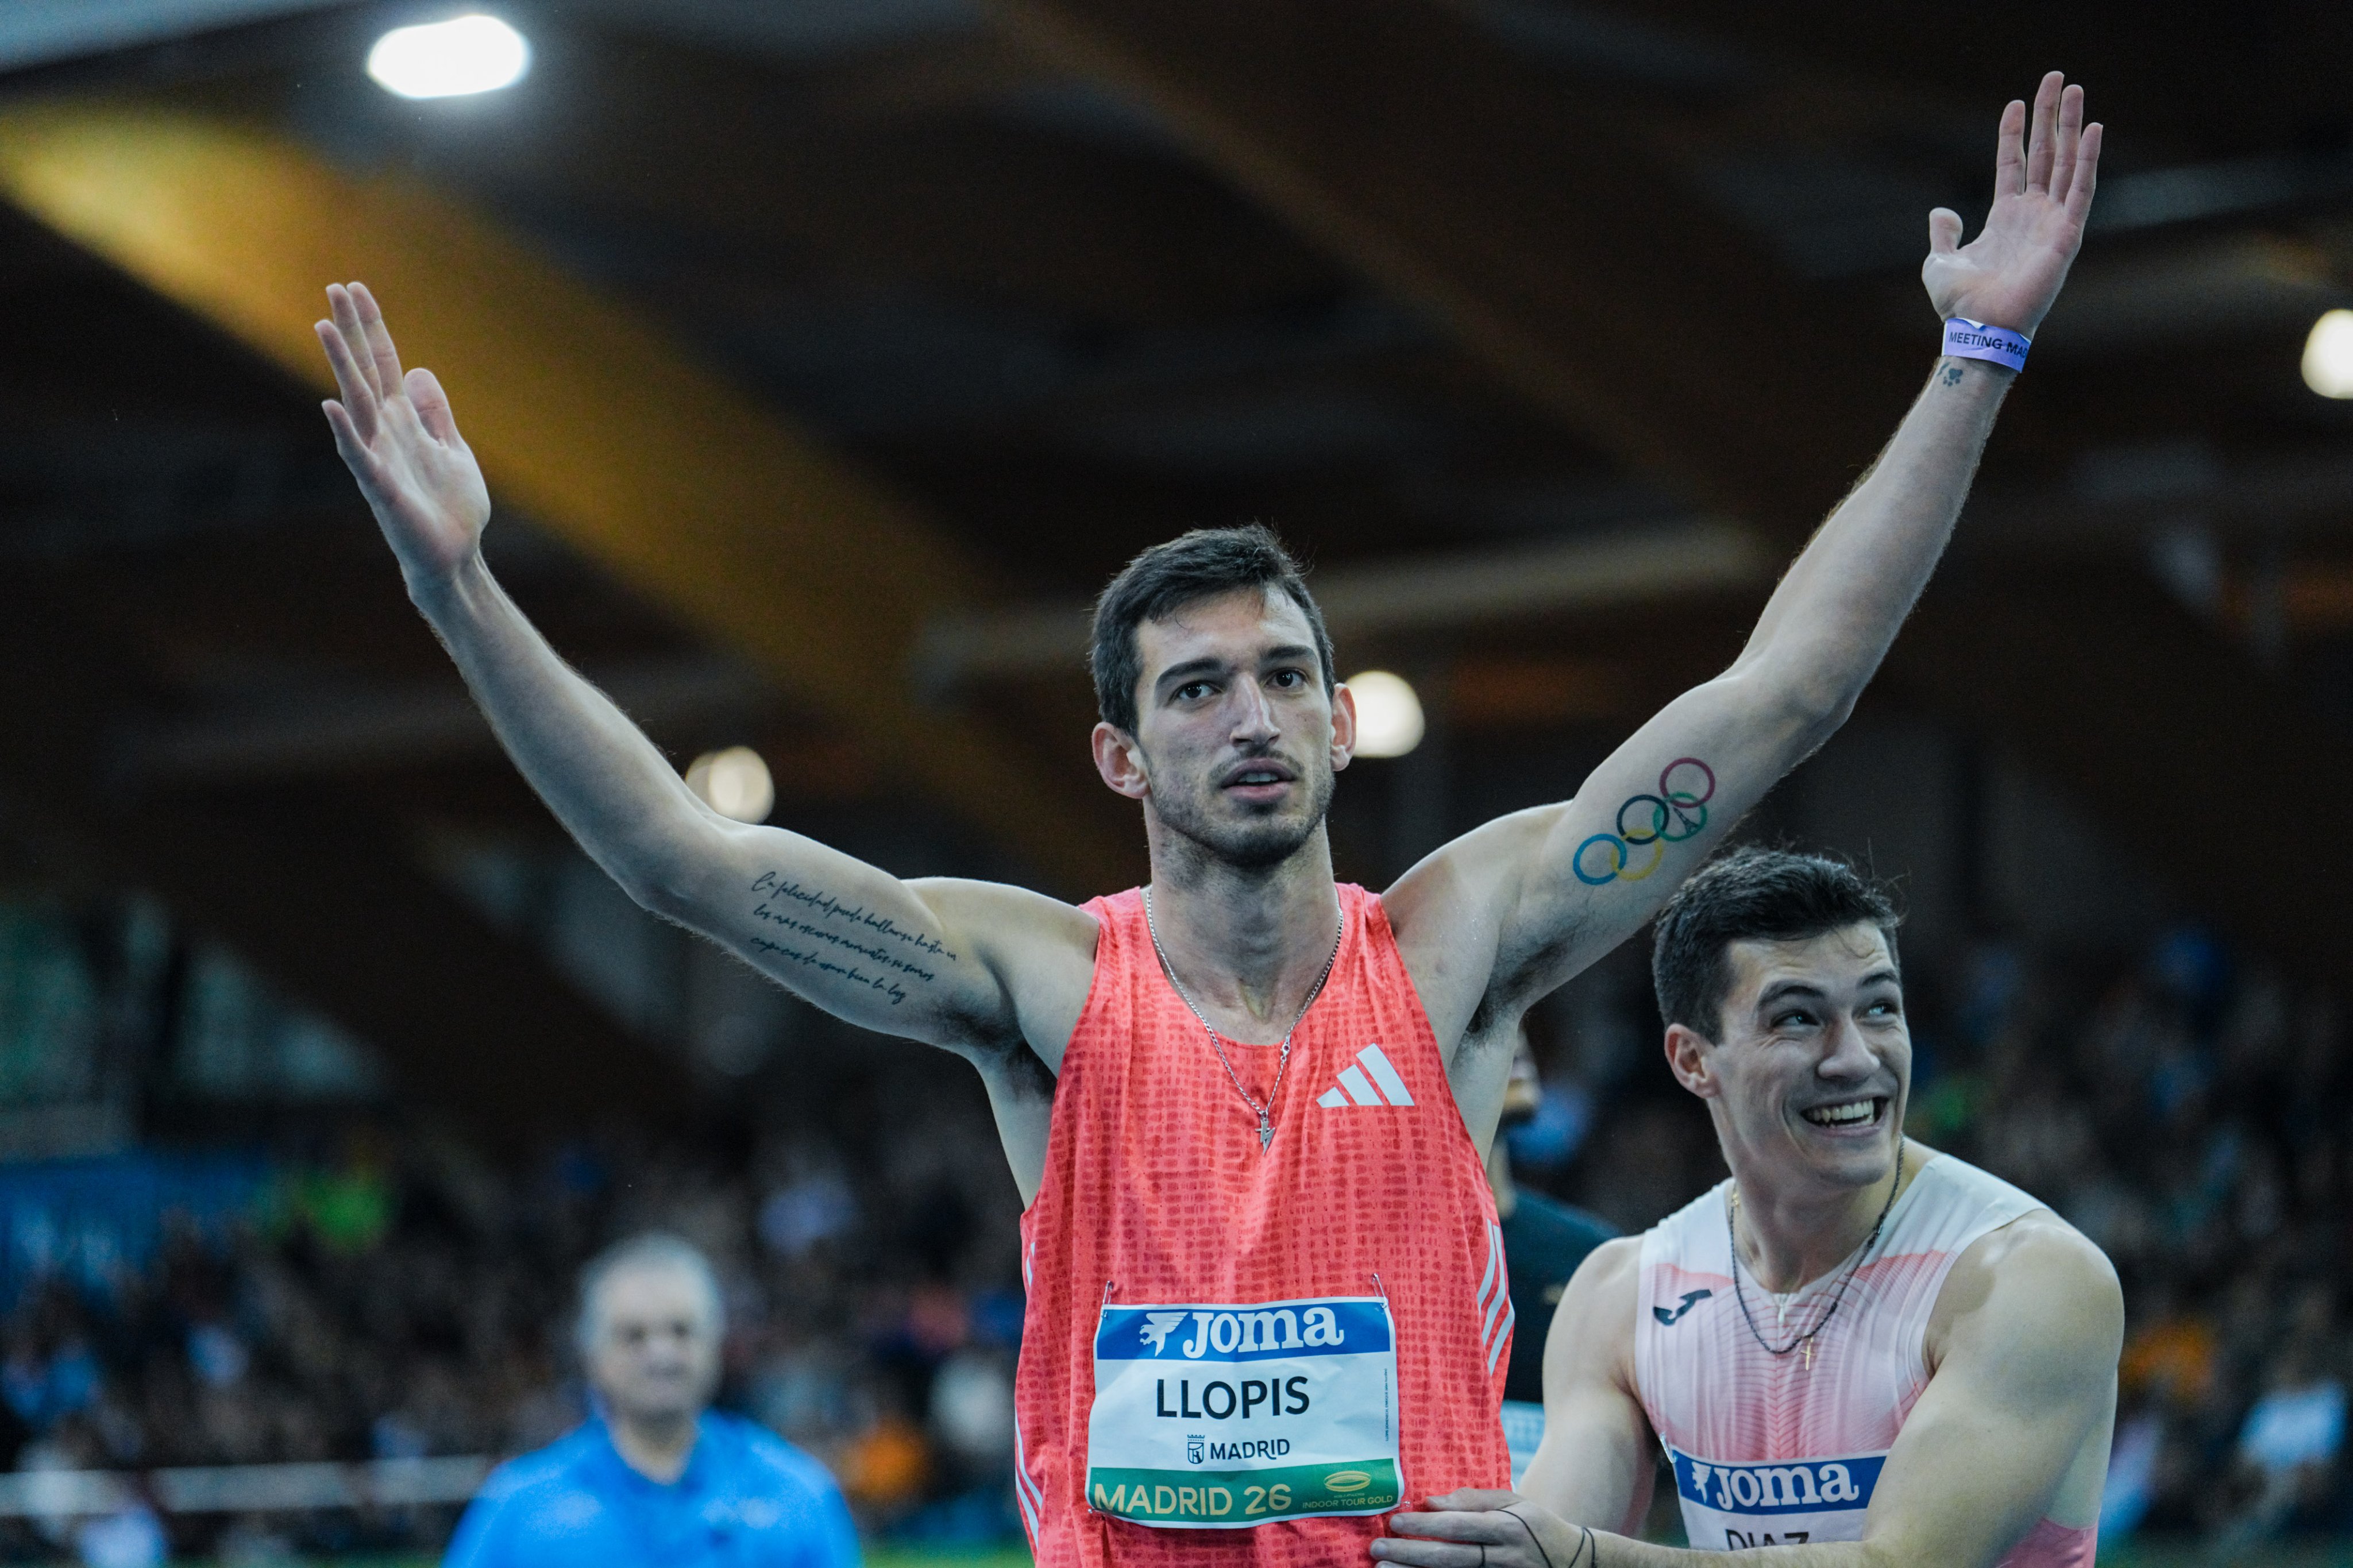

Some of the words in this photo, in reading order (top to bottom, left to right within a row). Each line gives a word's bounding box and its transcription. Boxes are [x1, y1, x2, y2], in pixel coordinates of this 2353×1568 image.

[1949, 332, 2003, 349] MEETING
[1156, 1376, 1310, 1419] LLOPIS
[1210, 1438, 1290, 1461] MADRID
[1094, 1485, 1233, 1516] MADRID
[1243, 1483, 1292, 1515] 26
[1302, 1500, 1339, 1509] INDOOR
[1341, 1497, 1365, 1506] TOUR
[1367, 1495, 1393, 1505] GOLD
